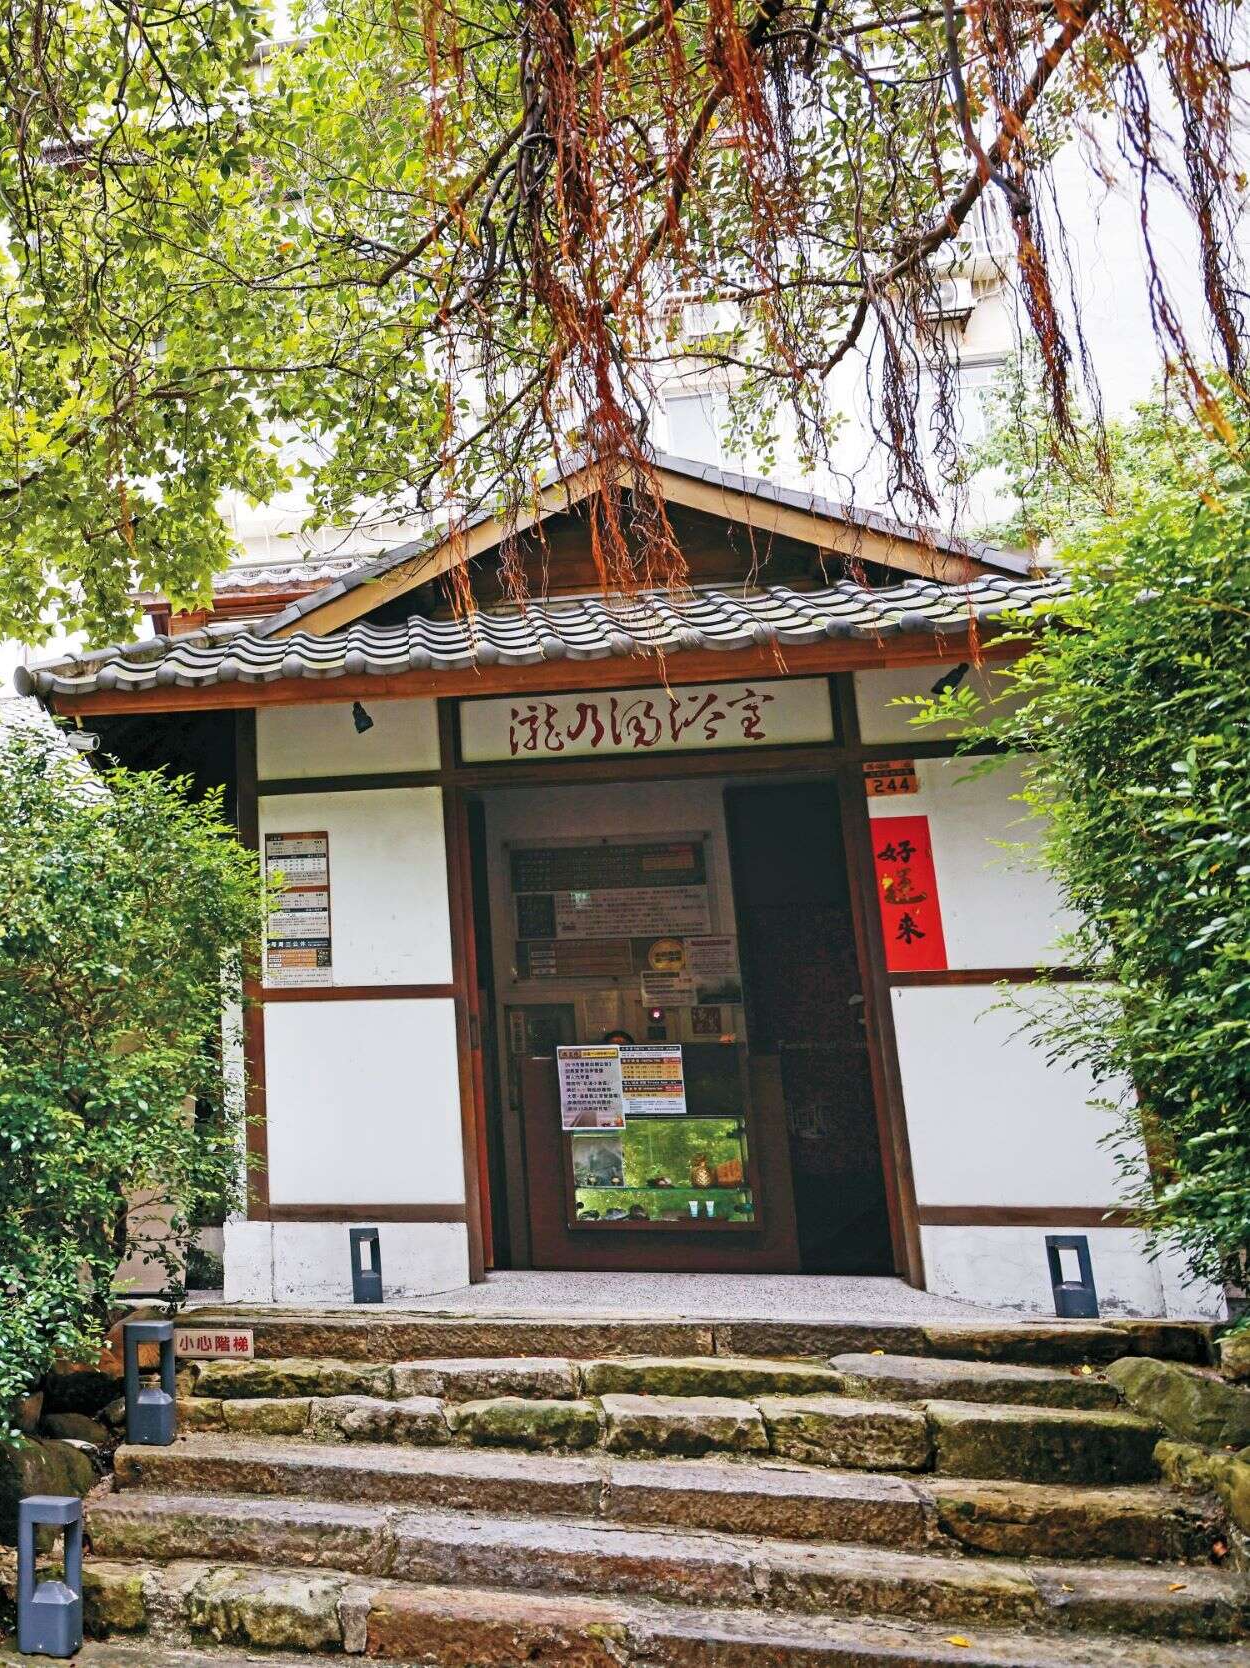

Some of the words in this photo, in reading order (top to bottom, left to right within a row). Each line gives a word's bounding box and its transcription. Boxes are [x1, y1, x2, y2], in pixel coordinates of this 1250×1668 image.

[874, 777, 910, 793] 244
[877, 840, 927, 944] 好運來
[179, 1335, 249, 1353] 小心階梯
